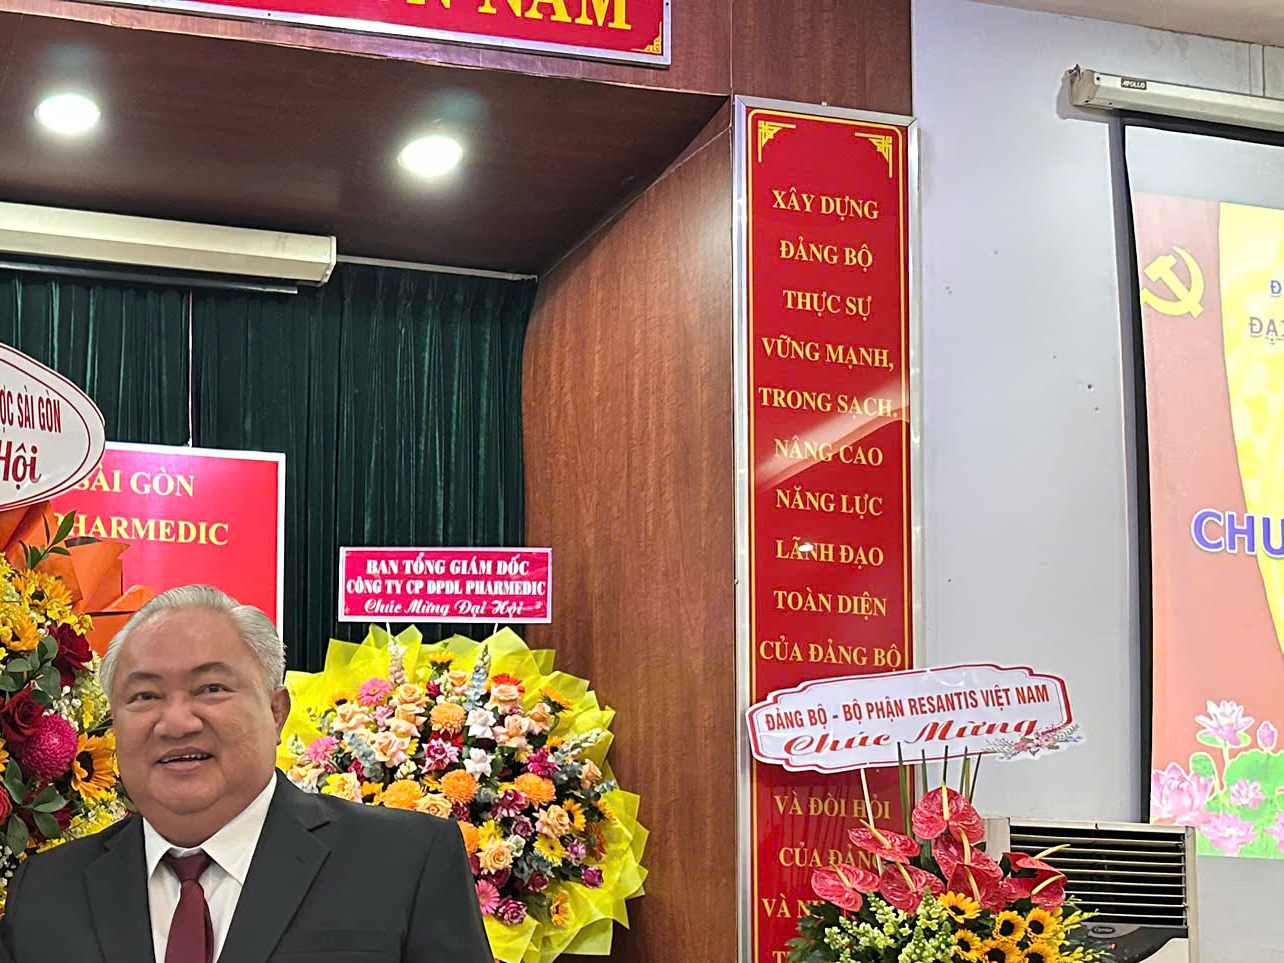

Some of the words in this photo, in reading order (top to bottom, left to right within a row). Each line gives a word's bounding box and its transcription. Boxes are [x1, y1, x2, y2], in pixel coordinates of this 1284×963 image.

[772, 187, 814, 213] XÂY
[820, 195, 879, 221] DỰNG
[779, 236, 838, 265] ĐẢNG
[844, 243, 873, 272] BỘ
[783, 290, 841, 317] THỰC
[846, 295, 872, 321] SỰ
[761, 334, 820, 361] VỮNG
[826, 344, 894, 371] MẠNH,
[17, 385, 36, 430] SÀI
[38, 389, 62, 433] GÒN
[758, 387, 832, 412] TRONG
[774, 435, 833, 462] NÂNG
[839, 445, 883, 467] CAO
[129, 466, 195, 497] GÒN
[776, 486, 835, 513] NĂNG
[840, 493, 883, 519] LỰC
[366, 559, 398, 575] BAN
[449, 556, 492, 576] GIÁM
[775, 536, 834, 563] LÃNH
[840, 545, 884, 569] ĐẠO
[346, 576, 382, 595] CÔNG
[385, 580, 404, 595] TY
[406, 580, 424, 595] CP
[427, 581, 462, 595] DPDL
[466, 580, 546, 596] PHARMEDIC
[364, 598, 402, 614] Chúc
[404, 599, 450, 616] Mừng
[454, 601, 487, 617] Đại
[490, 599, 523, 618] Hội
[773, 587, 832, 614] TOÀN
[837, 591, 887, 620] DIỆN
[759, 635, 803, 662] CỦA
[808, 638, 868, 666] ĐẢNG
[873, 643, 902, 672] BỘ
[765, 708, 805, 731] ĐẢNG
[807, 703, 828, 729] BỘ
[842, 698, 862, 725] BỘ
[866, 696, 905, 722] PHẬN
[908, 690, 978, 716] RESANTIS
[980, 684, 1011, 711] VIỆT
[1015, 684, 1050, 705] NAM
[783, 732, 891, 757] Chúc
[905, 719, 1038, 744] Mừng
[774, 790, 804, 815] VÀ
[808, 792, 847, 817] ĐÒI
[779, 841, 823, 867] CỦA
[762, 892, 791, 918] VÀ
